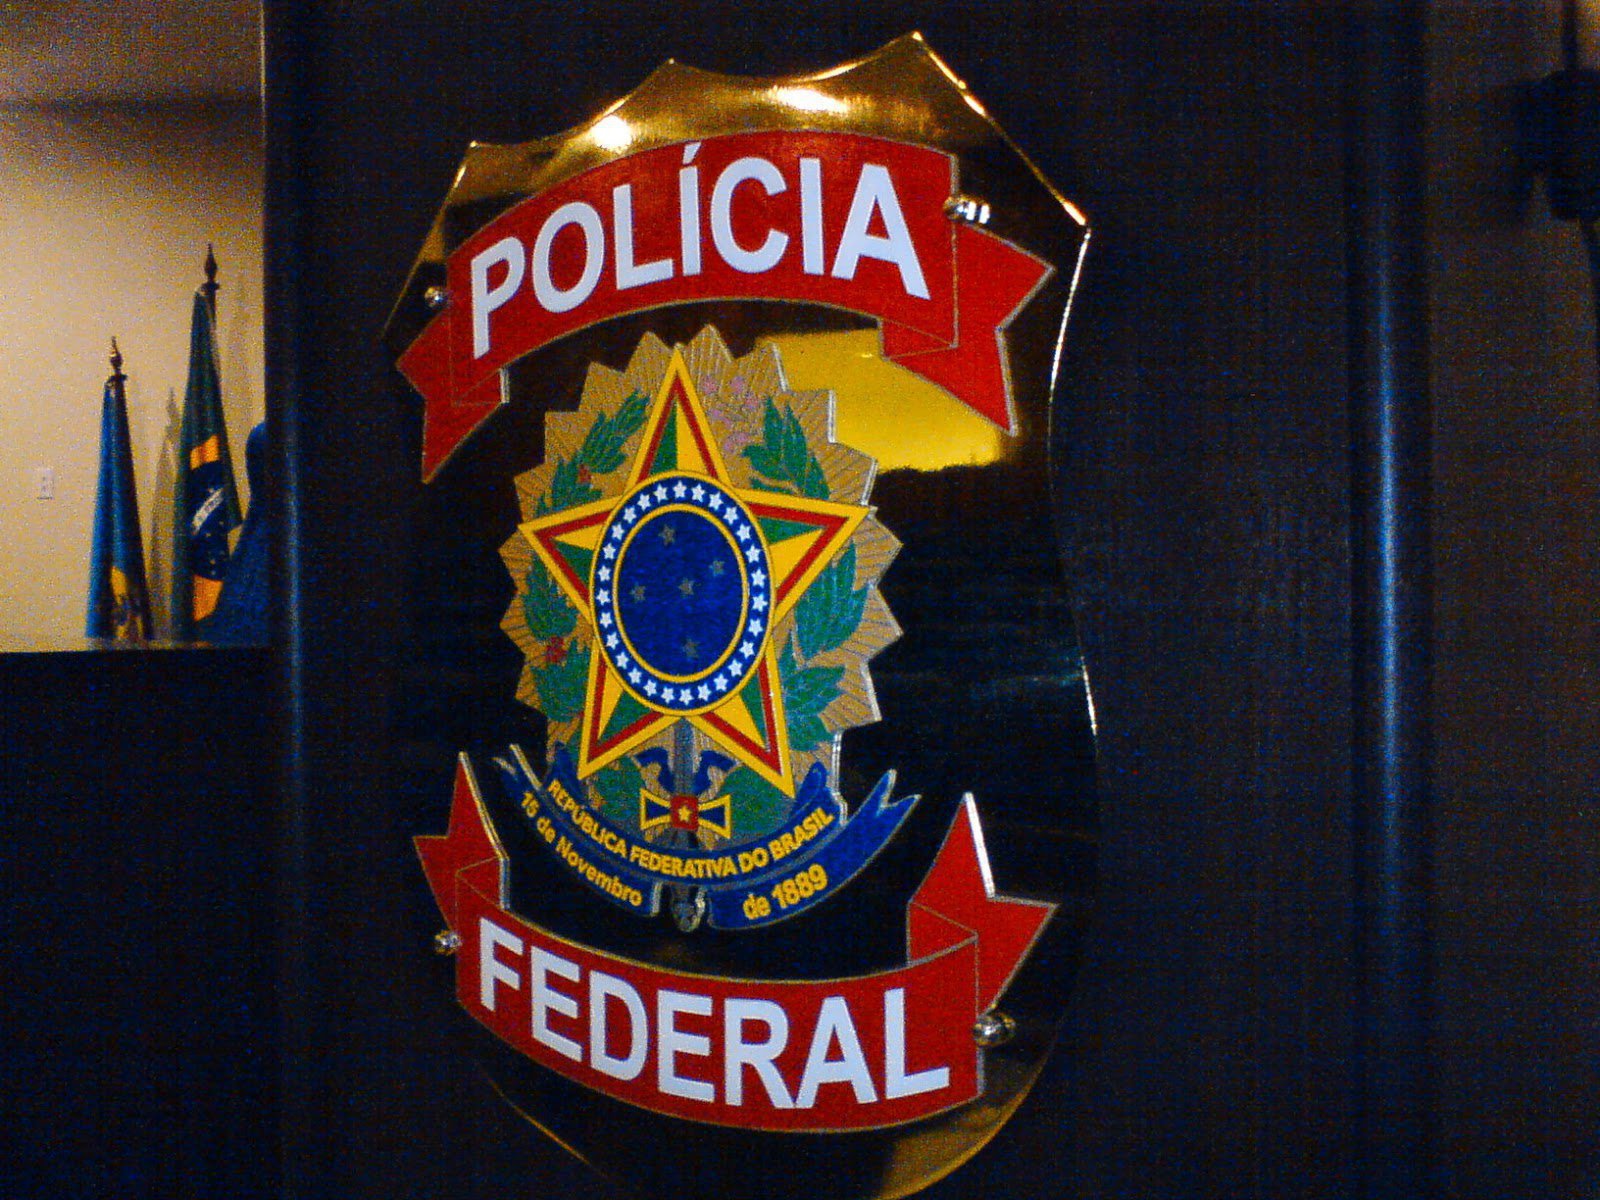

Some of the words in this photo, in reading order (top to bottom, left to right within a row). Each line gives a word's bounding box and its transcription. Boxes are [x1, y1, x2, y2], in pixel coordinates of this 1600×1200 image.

[471, 142, 931, 359] POLÍCIA
[520, 791, 539, 818] 15
[536, 815, 556, 844] de
[555, 838, 643, 906] Novembro
[547, 779, 628, 858] REPÚBLICA
[629, 847, 735, 878] FEDERATIVA
[738, 847, 769, 872] DO
[768, 807, 835, 861] BRASIL
[742, 893, 771, 920] de
[771, 864, 829, 908] 1889
[479, 917, 950, 1109] FEDERAL
